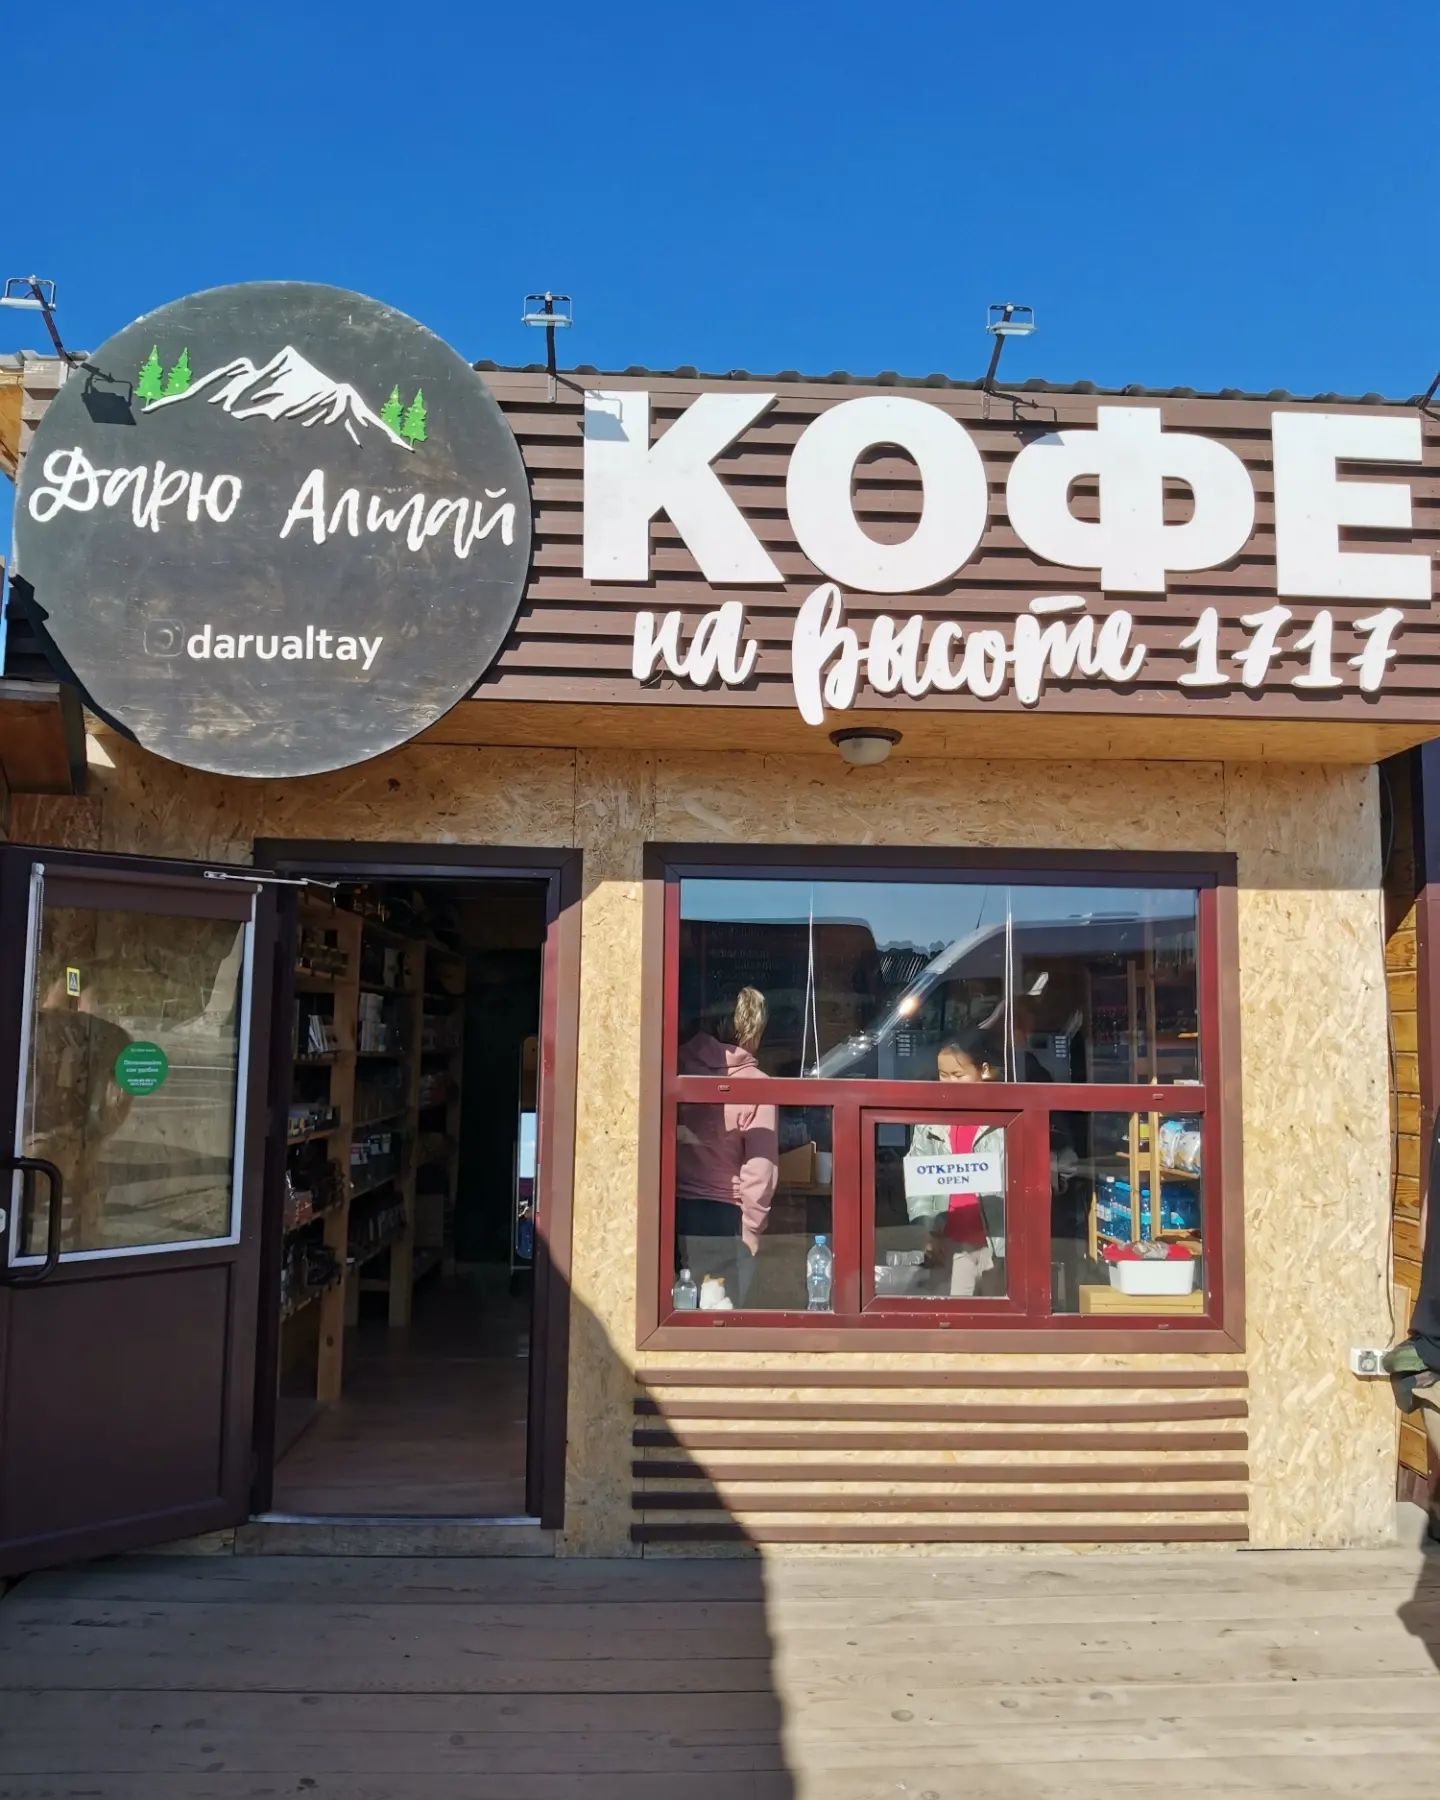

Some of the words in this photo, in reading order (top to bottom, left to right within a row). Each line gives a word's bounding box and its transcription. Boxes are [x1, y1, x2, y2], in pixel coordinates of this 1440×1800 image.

[28, 446, 242, 533] Дарю
[279, 468, 515, 559] Алтай
[583, 390, 1432, 600] КОФЕ
[186, 624, 384, 670] darualtay
[632, 601, 758, 686] на
[791, 582, 1147, 726] высоте
[1177, 606, 1404, 692] 1717
[916, 1162, 989, 1175] ОТКРЫТО
[937, 1175, 970, 1185] OPEN
